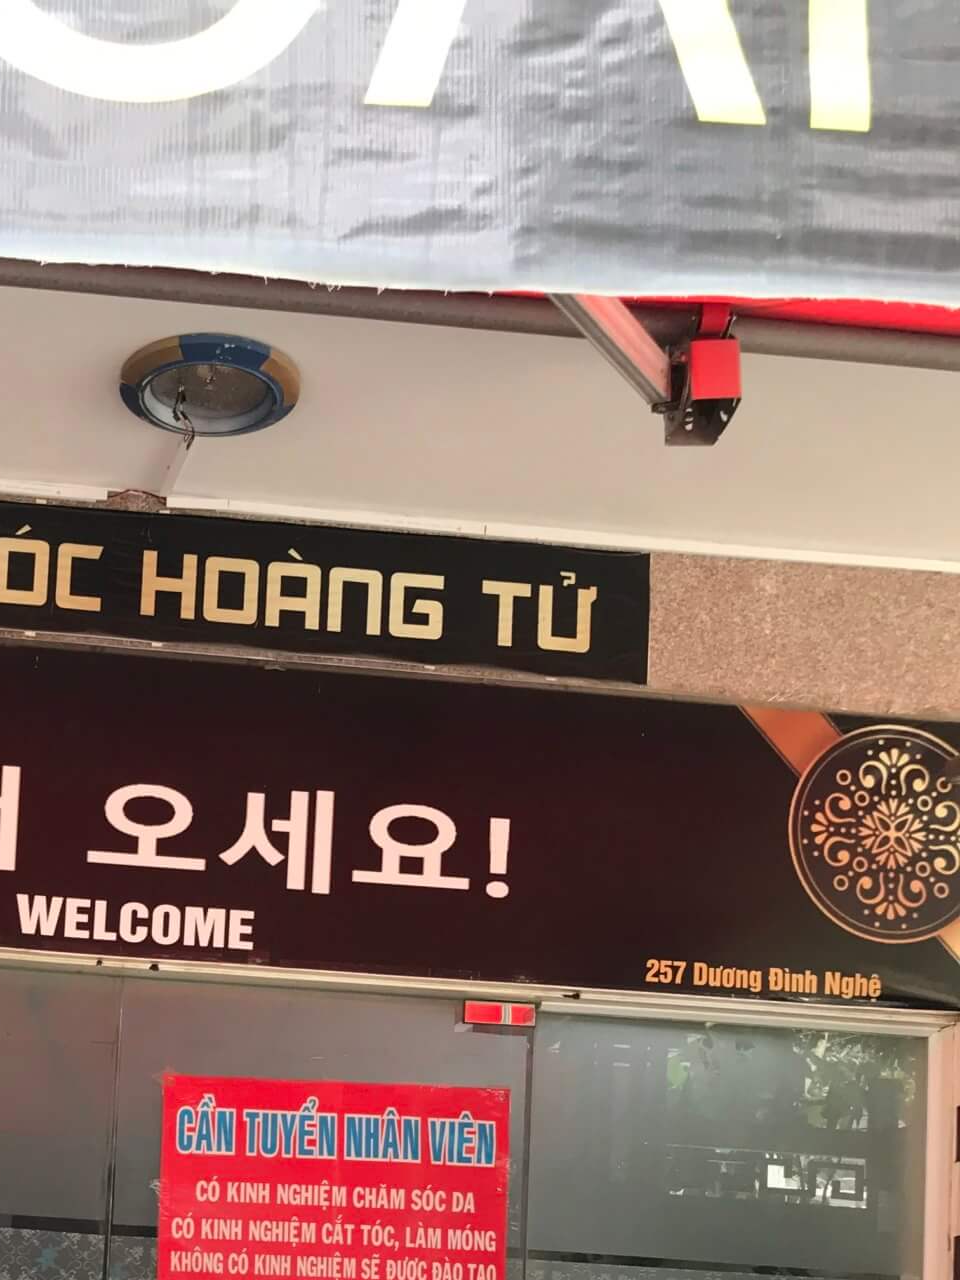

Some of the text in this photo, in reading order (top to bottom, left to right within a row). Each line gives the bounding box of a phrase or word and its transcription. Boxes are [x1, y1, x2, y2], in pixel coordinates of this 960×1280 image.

[139, 547, 446, 641] HOÀNG
[481, 570, 598, 654] TỬ
[86, 783, 512, 899] 오세요!
[16, 893, 256, 951] WELCOME
[645, 958, 687, 985] 257
[693, 961, 762, 993] Dương
[768, 967, 818, 994] Đình
[176, 1093, 496, 1168] CẦN TUYỂN NHÂN VIÊN
[195, 1176, 476, 1213] CÓ KINH NGHIỆM CHĂM SÓC DA
[171, 1212, 497, 1252] CÓ KINH NGHIỆM CẮT TÓC, LÀM MÓNG
[169, 1246, 224, 1274] KHÔNG
[227, 1248, 249, 1275] CÓ
[254, 1253, 291, 1276] KINH
[360, 1254, 380, 1280] SẼ
